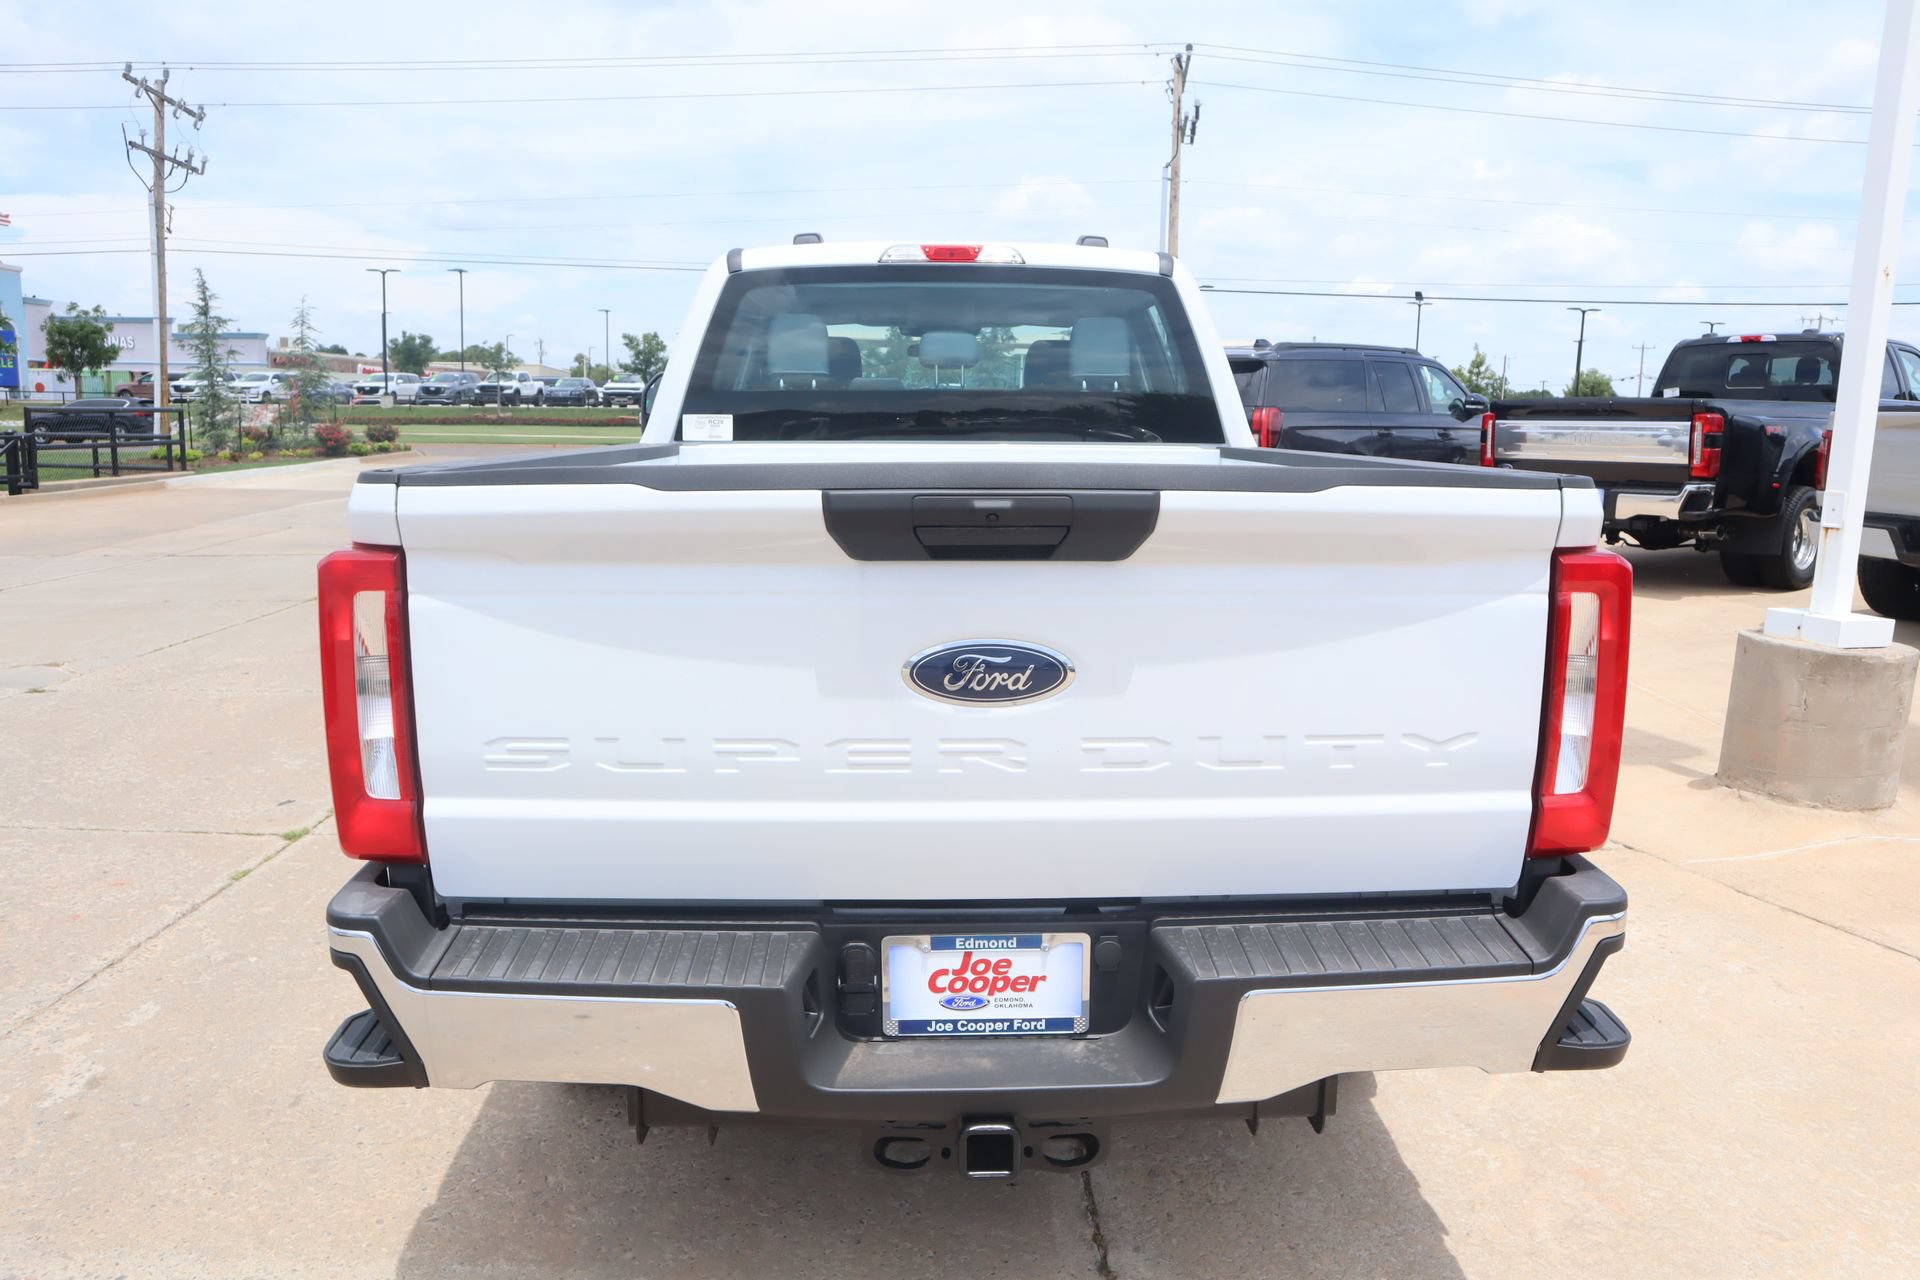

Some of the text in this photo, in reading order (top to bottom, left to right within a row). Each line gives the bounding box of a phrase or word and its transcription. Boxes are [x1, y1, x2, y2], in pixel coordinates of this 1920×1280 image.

[944, 654, 1035, 691] Ford
[483, 731, 1480, 773] SUPER DUTY
[955, 937, 1017, 949] Edmond
[951, 951, 1013, 976] Joe
[928, 969, 1047, 996] Cooper
[951, 996, 977, 1007] Ford
[926, 1018, 1046, 1033] Joe Cooper Ford
